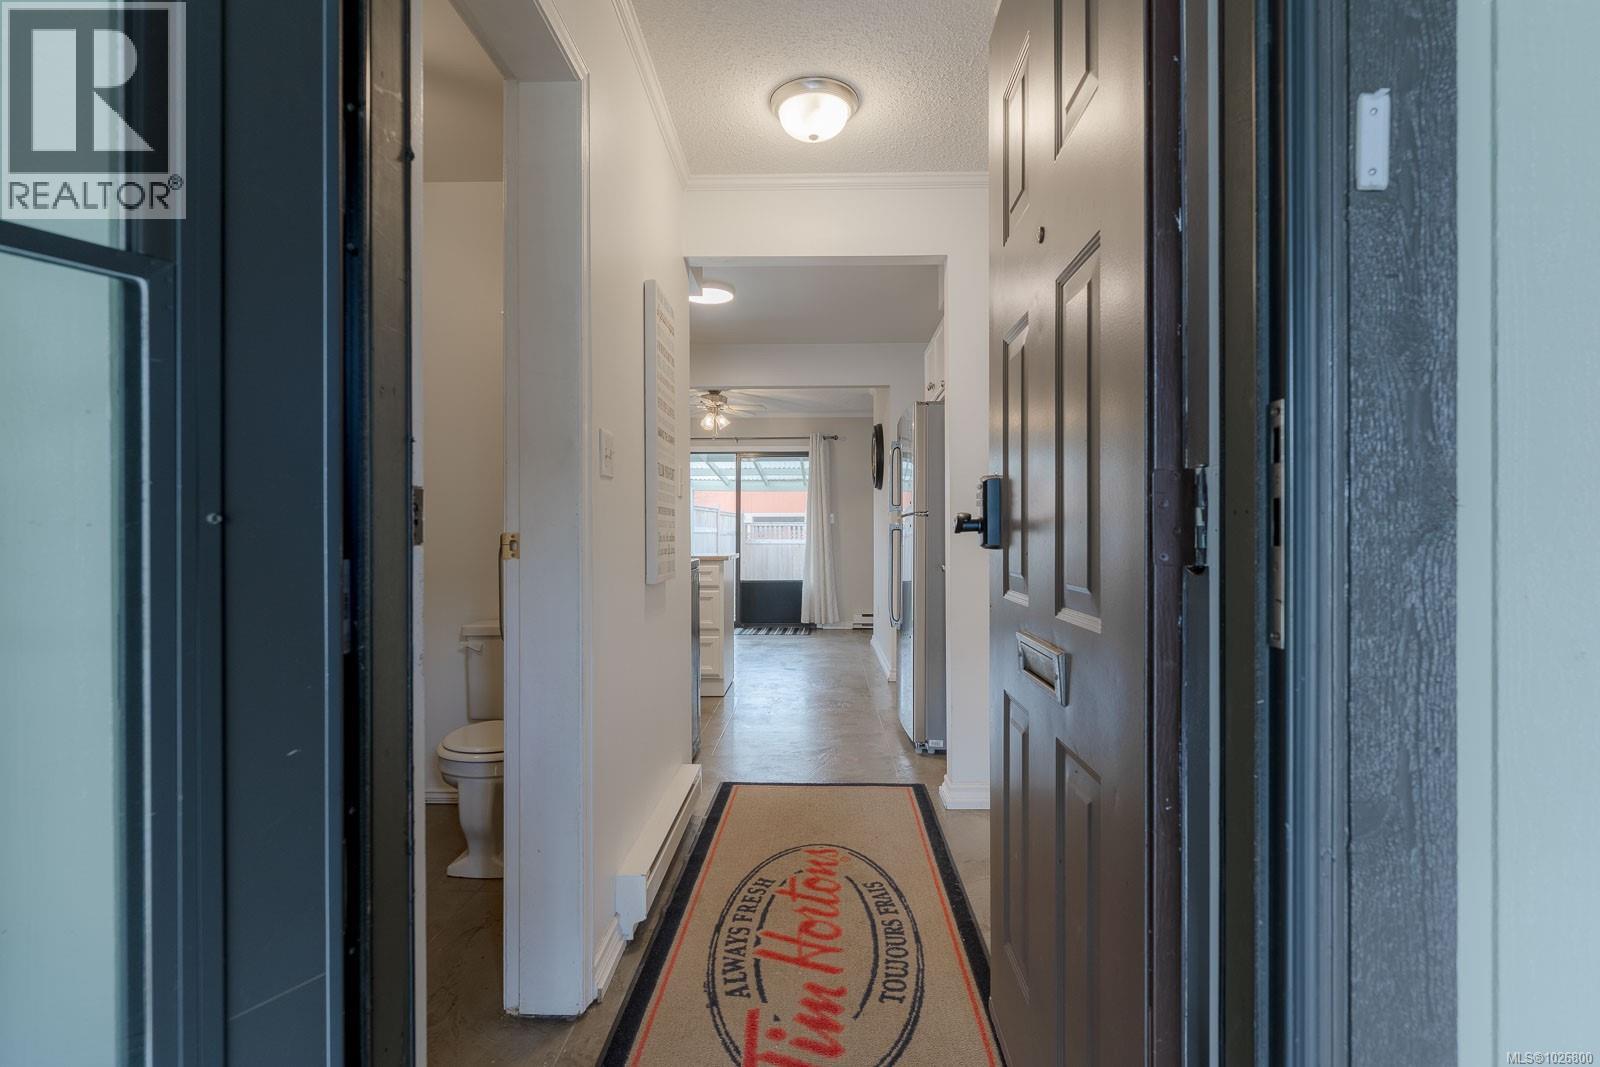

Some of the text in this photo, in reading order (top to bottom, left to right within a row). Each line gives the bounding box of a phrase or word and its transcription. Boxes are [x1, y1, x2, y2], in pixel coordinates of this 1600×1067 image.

[722, 877, 776, 999] ALWAYS FRESH
[752, 848, 843, 975] Hortons
[862, 881, 909, 1004] TOUJOURS FRAIS
